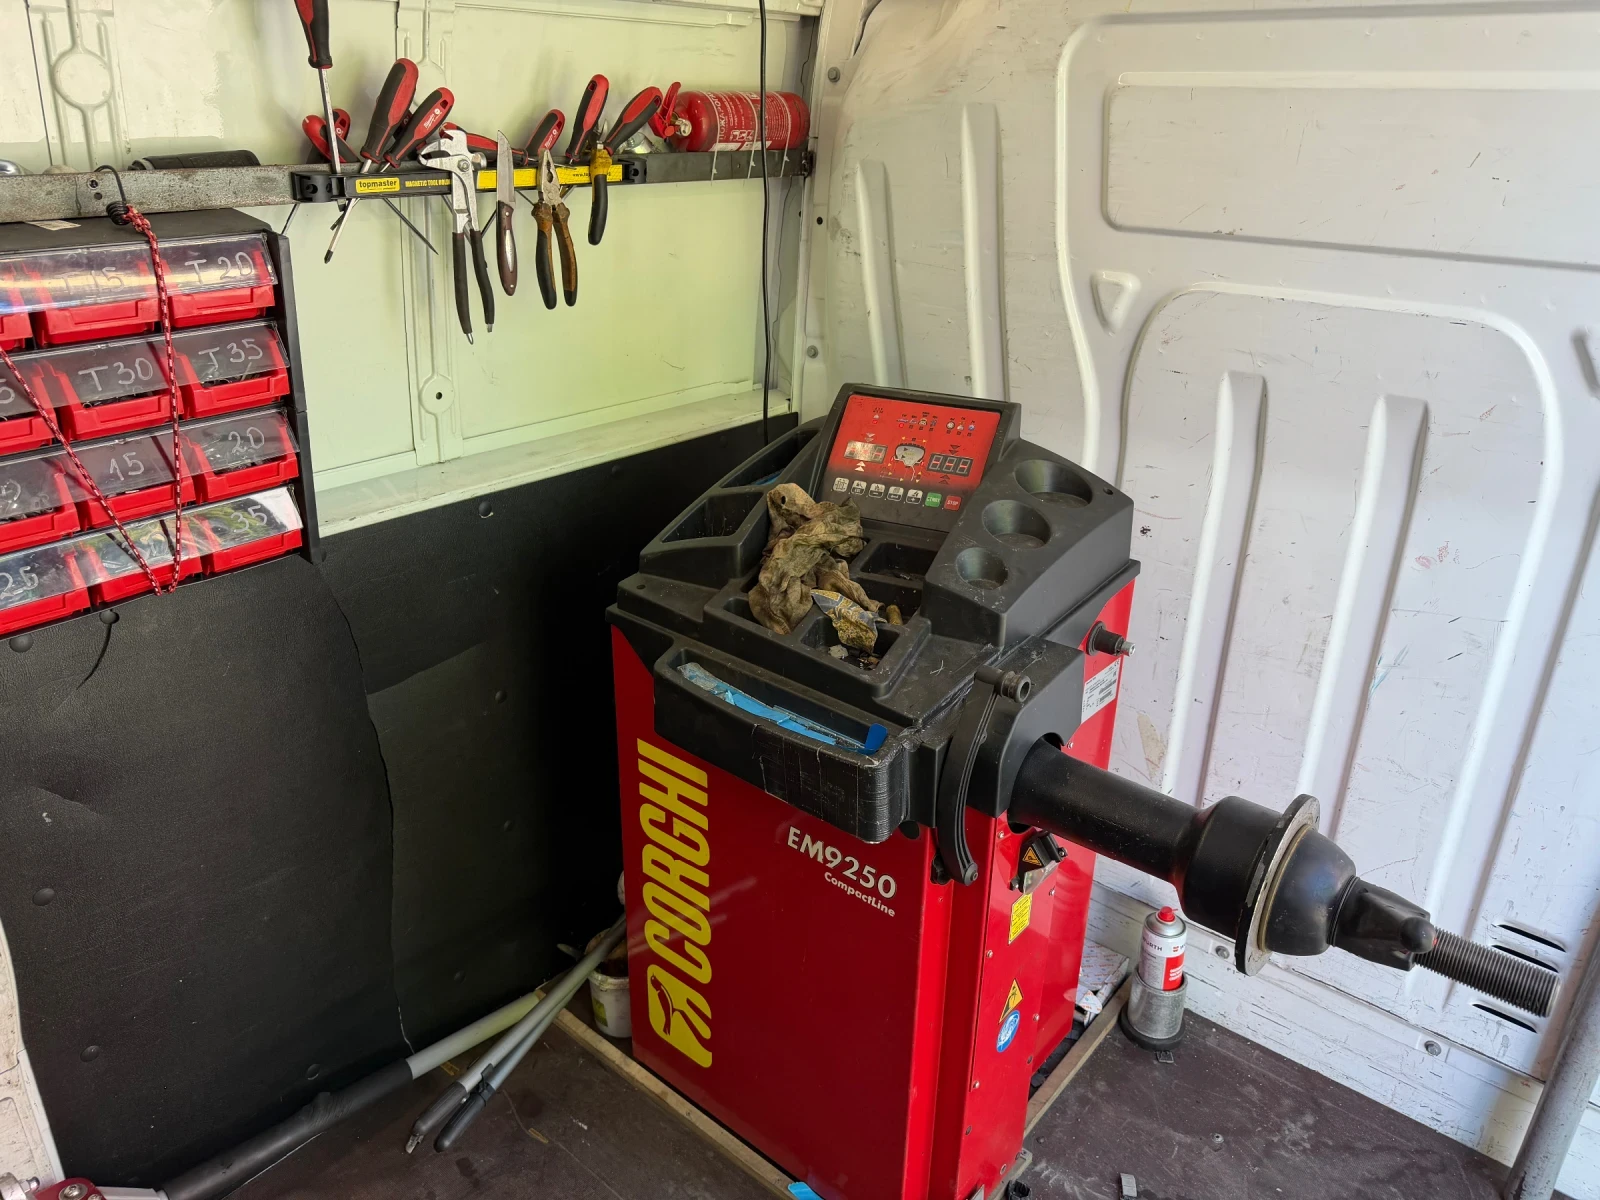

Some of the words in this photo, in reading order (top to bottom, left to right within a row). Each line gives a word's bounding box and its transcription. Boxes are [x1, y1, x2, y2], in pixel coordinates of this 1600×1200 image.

[359, 179, 397, 188] topmaster
[228, 426, 266, 455] 20
[109, 451, 145, 482] 15
[230, 504, 268, 534] 35
[637, 738, 712, 984] CORGHI
[787, 826, 897, 899] EM9250
[824, 871, 896, 917] CompactLine
